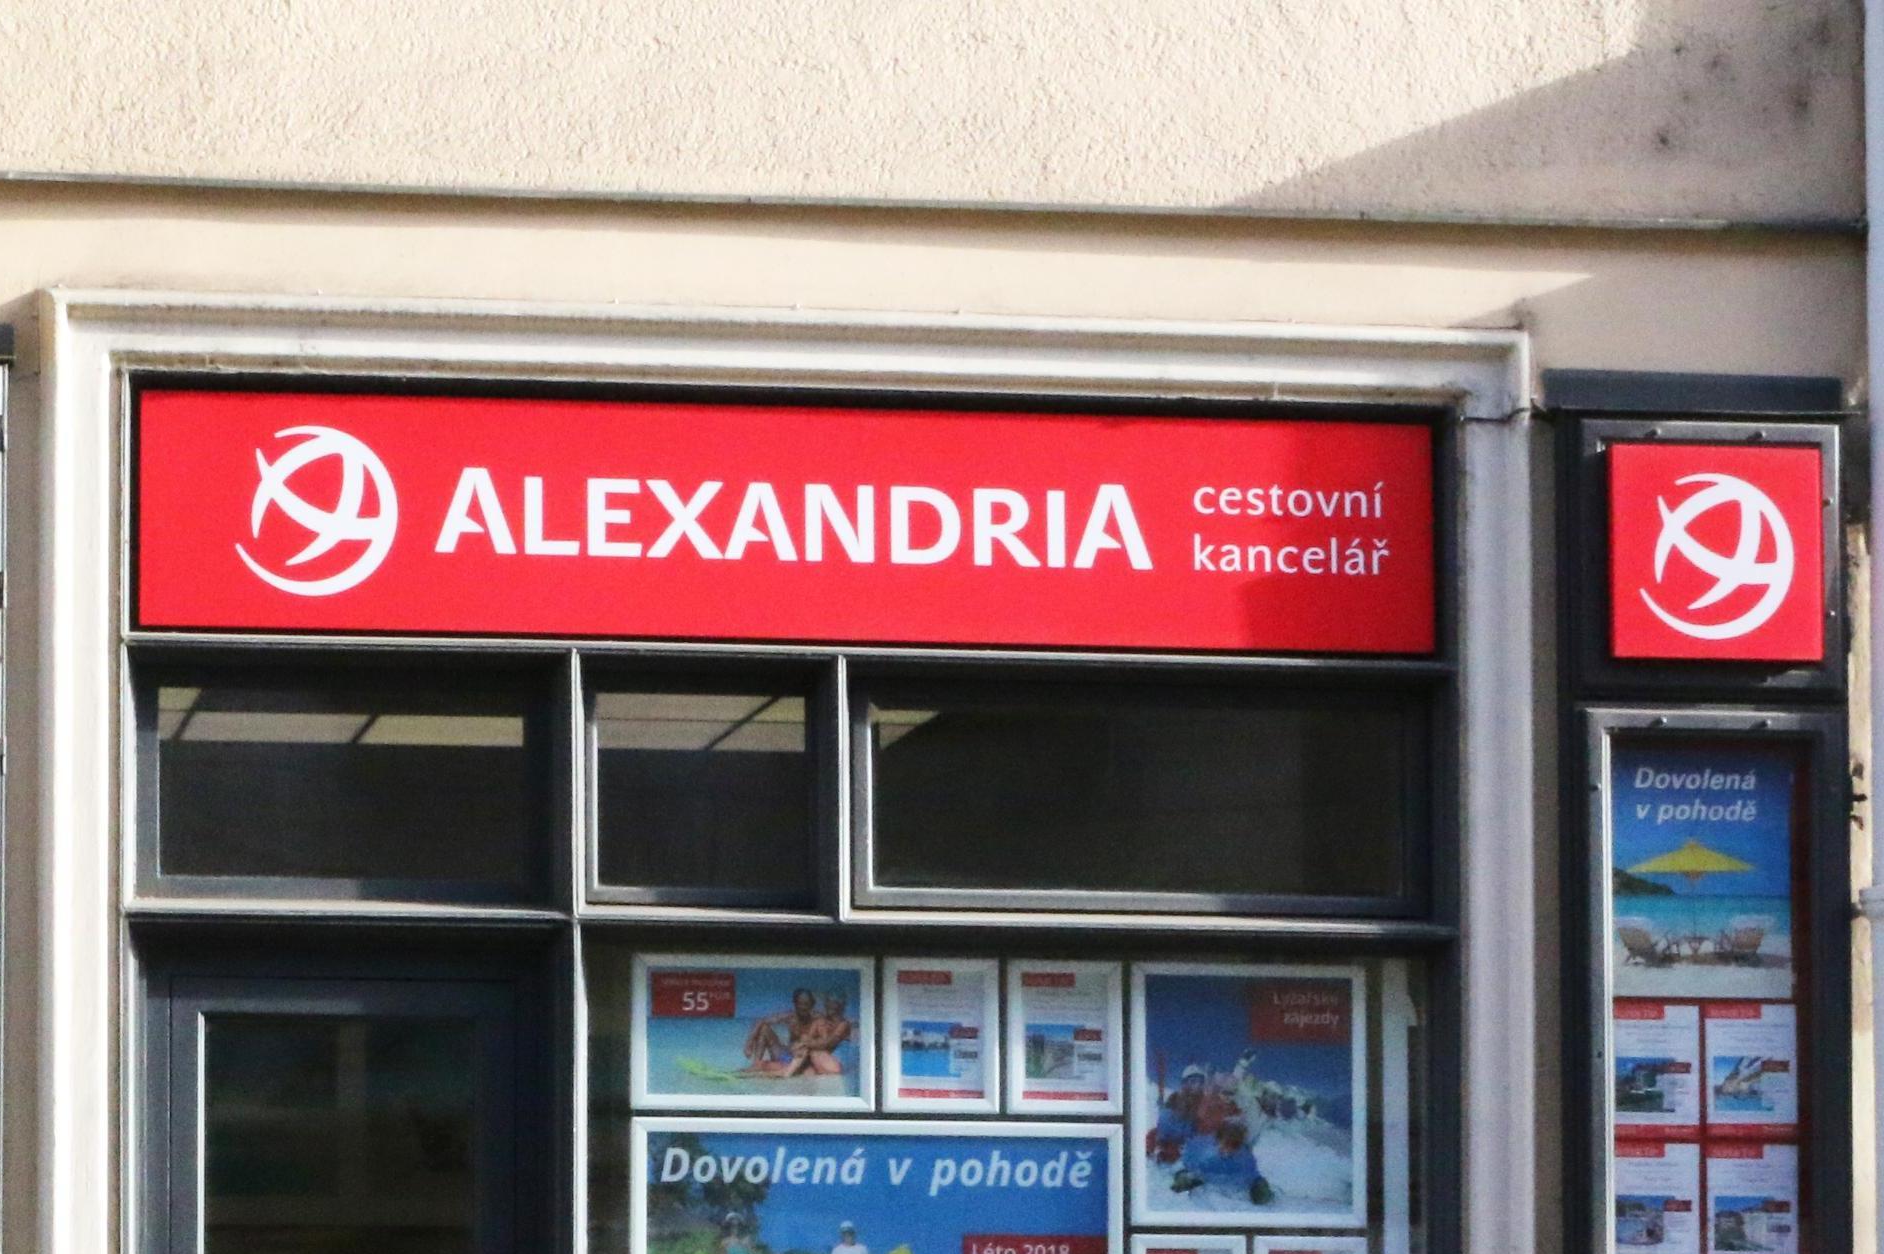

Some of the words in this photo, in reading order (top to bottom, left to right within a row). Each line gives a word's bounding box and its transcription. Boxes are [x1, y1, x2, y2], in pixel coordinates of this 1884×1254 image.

[434, 466, 1154, 570] ALEXANDRIA
[1192, 481, 1384, 519] cestovní
[1192, 532, 1392, 576] kancelář
[1634, 766, 1758, 792] Dovolená
[1635, 803, 1651, 822] v
[1656, 798, 1759, 826] pohodě
[681, 990, 710, 1011] 55
[660, 1146, 866, 1186] Dovolená
[887, 1157, 912, 1185] v
[929, 1149, 1094, 1198] pohodě
